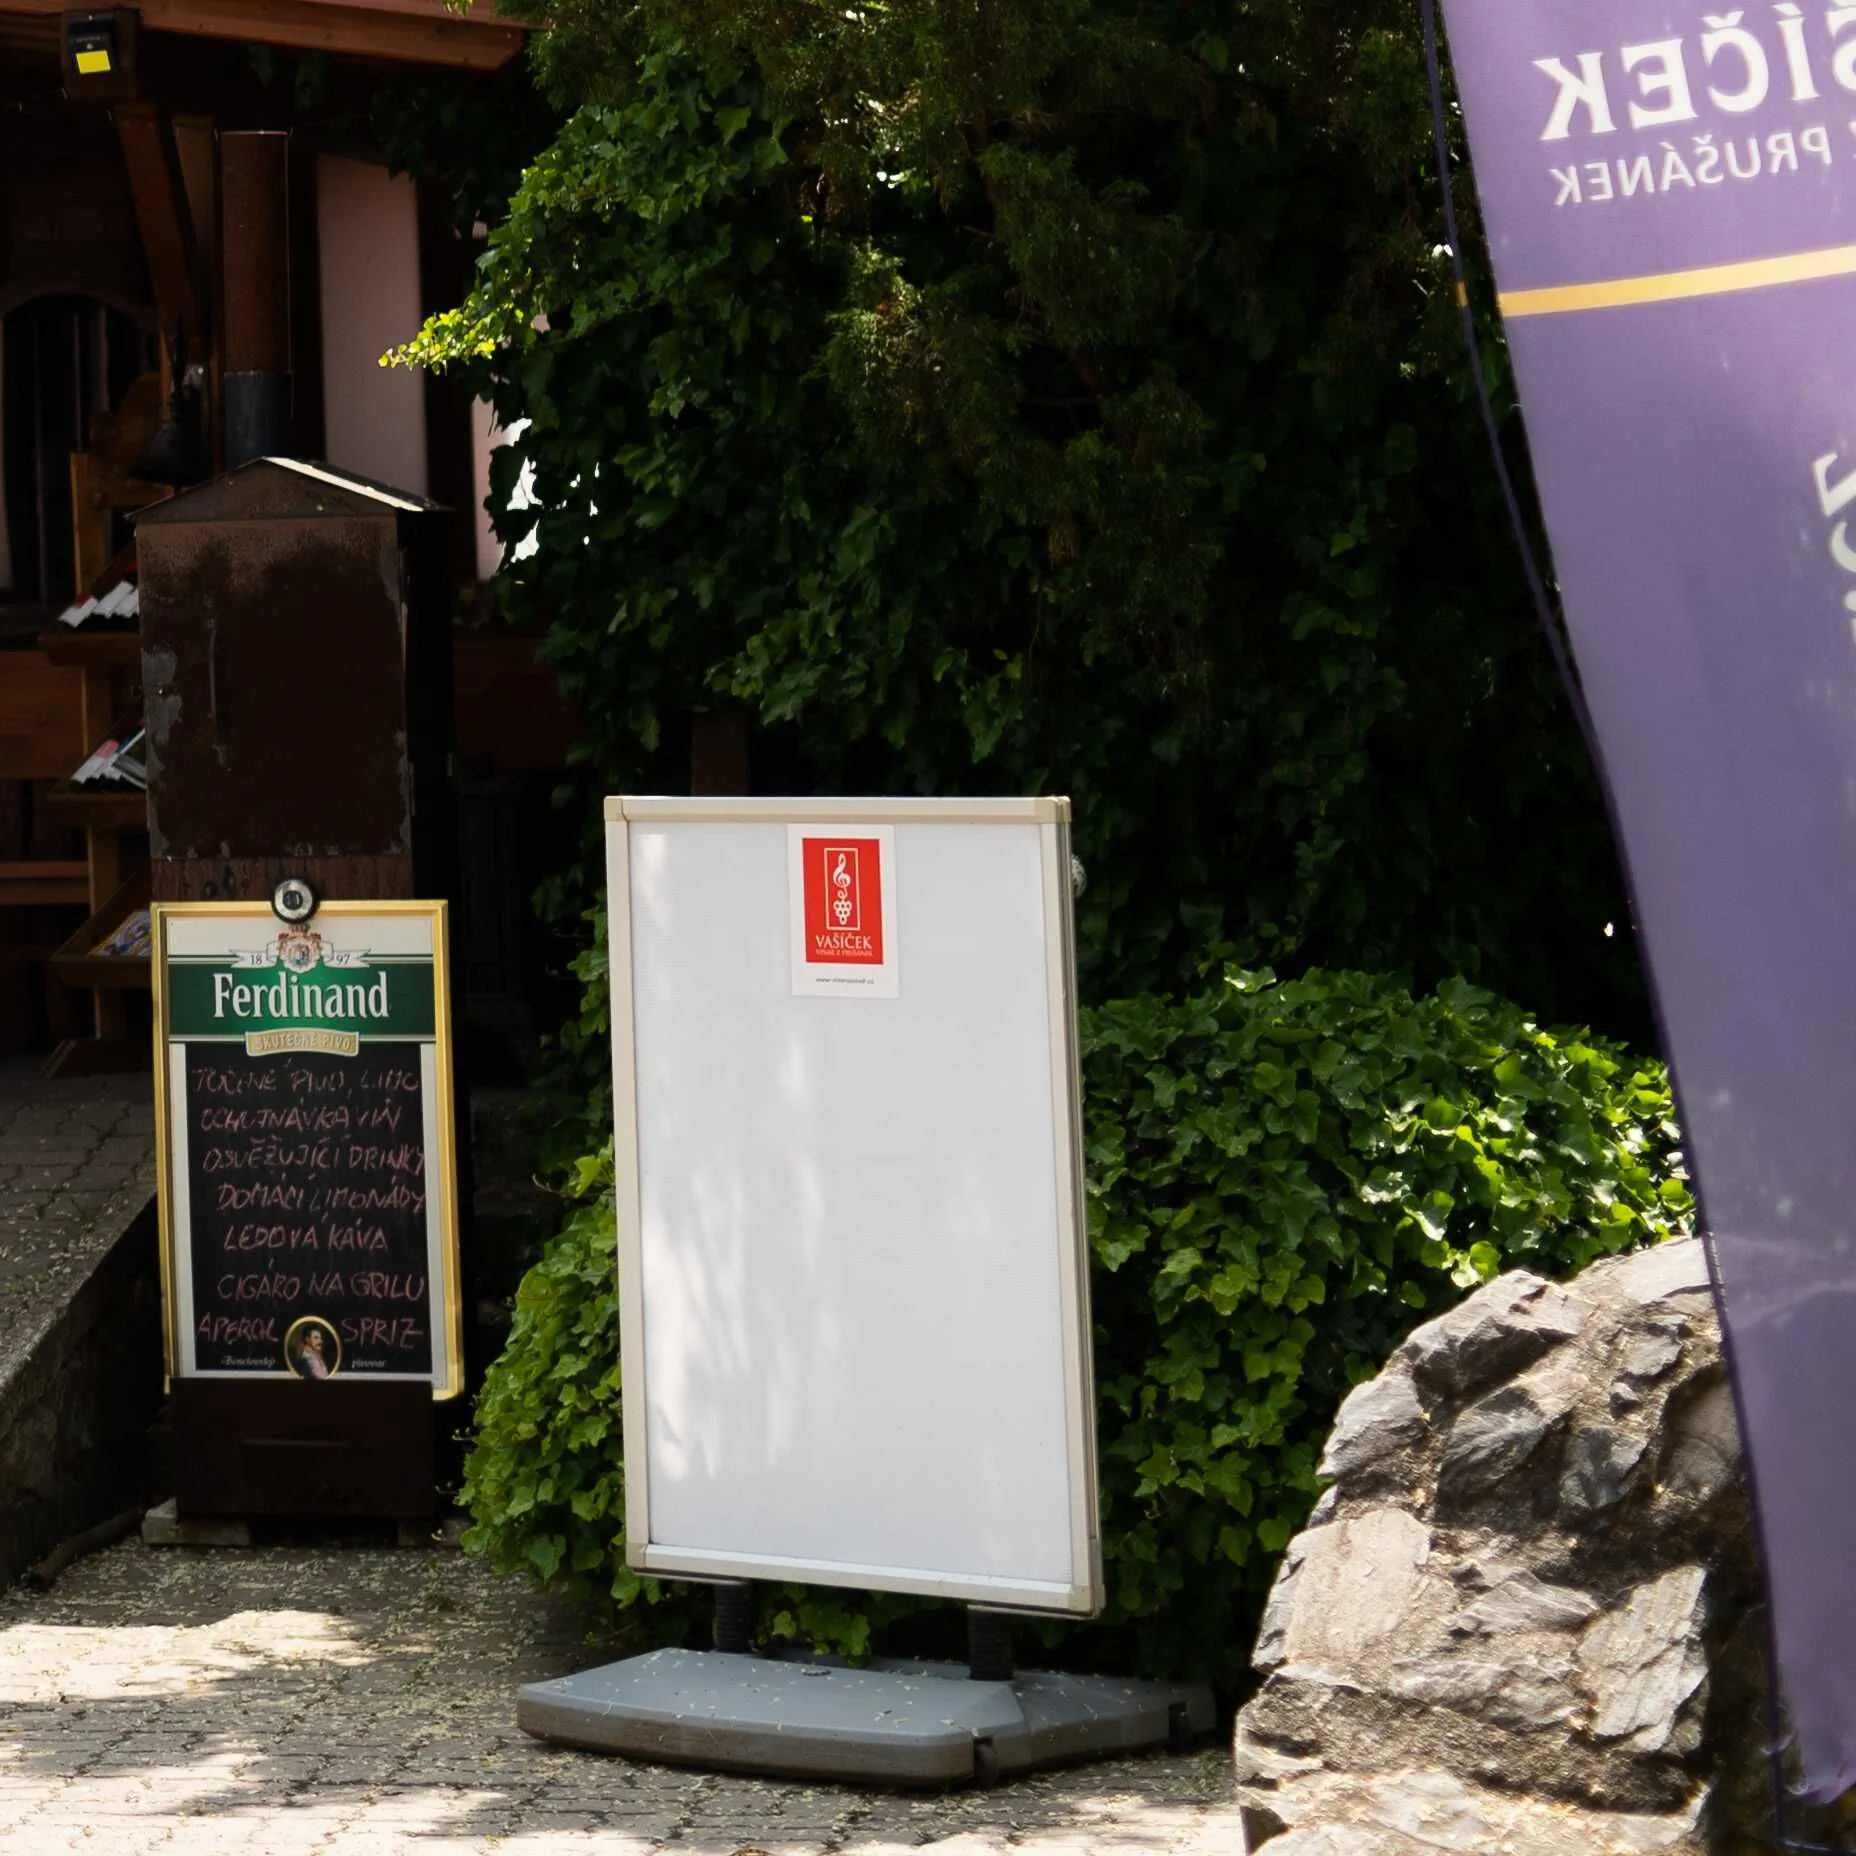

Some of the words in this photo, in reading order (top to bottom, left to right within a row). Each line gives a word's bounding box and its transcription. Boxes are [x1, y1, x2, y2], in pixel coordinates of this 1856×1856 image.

[815, 932, 873, 950] VAŠÍČEK
[248, 953, 263, 965] 18
[335, 952, 351, 965] 97
[213, 971, 390, 1020] Ferdinand
[308, 1271, 344, 1298] NA
[350, 1270, 425, 1302] GRILU
[196, 1311, 280, 1346] APEROL
